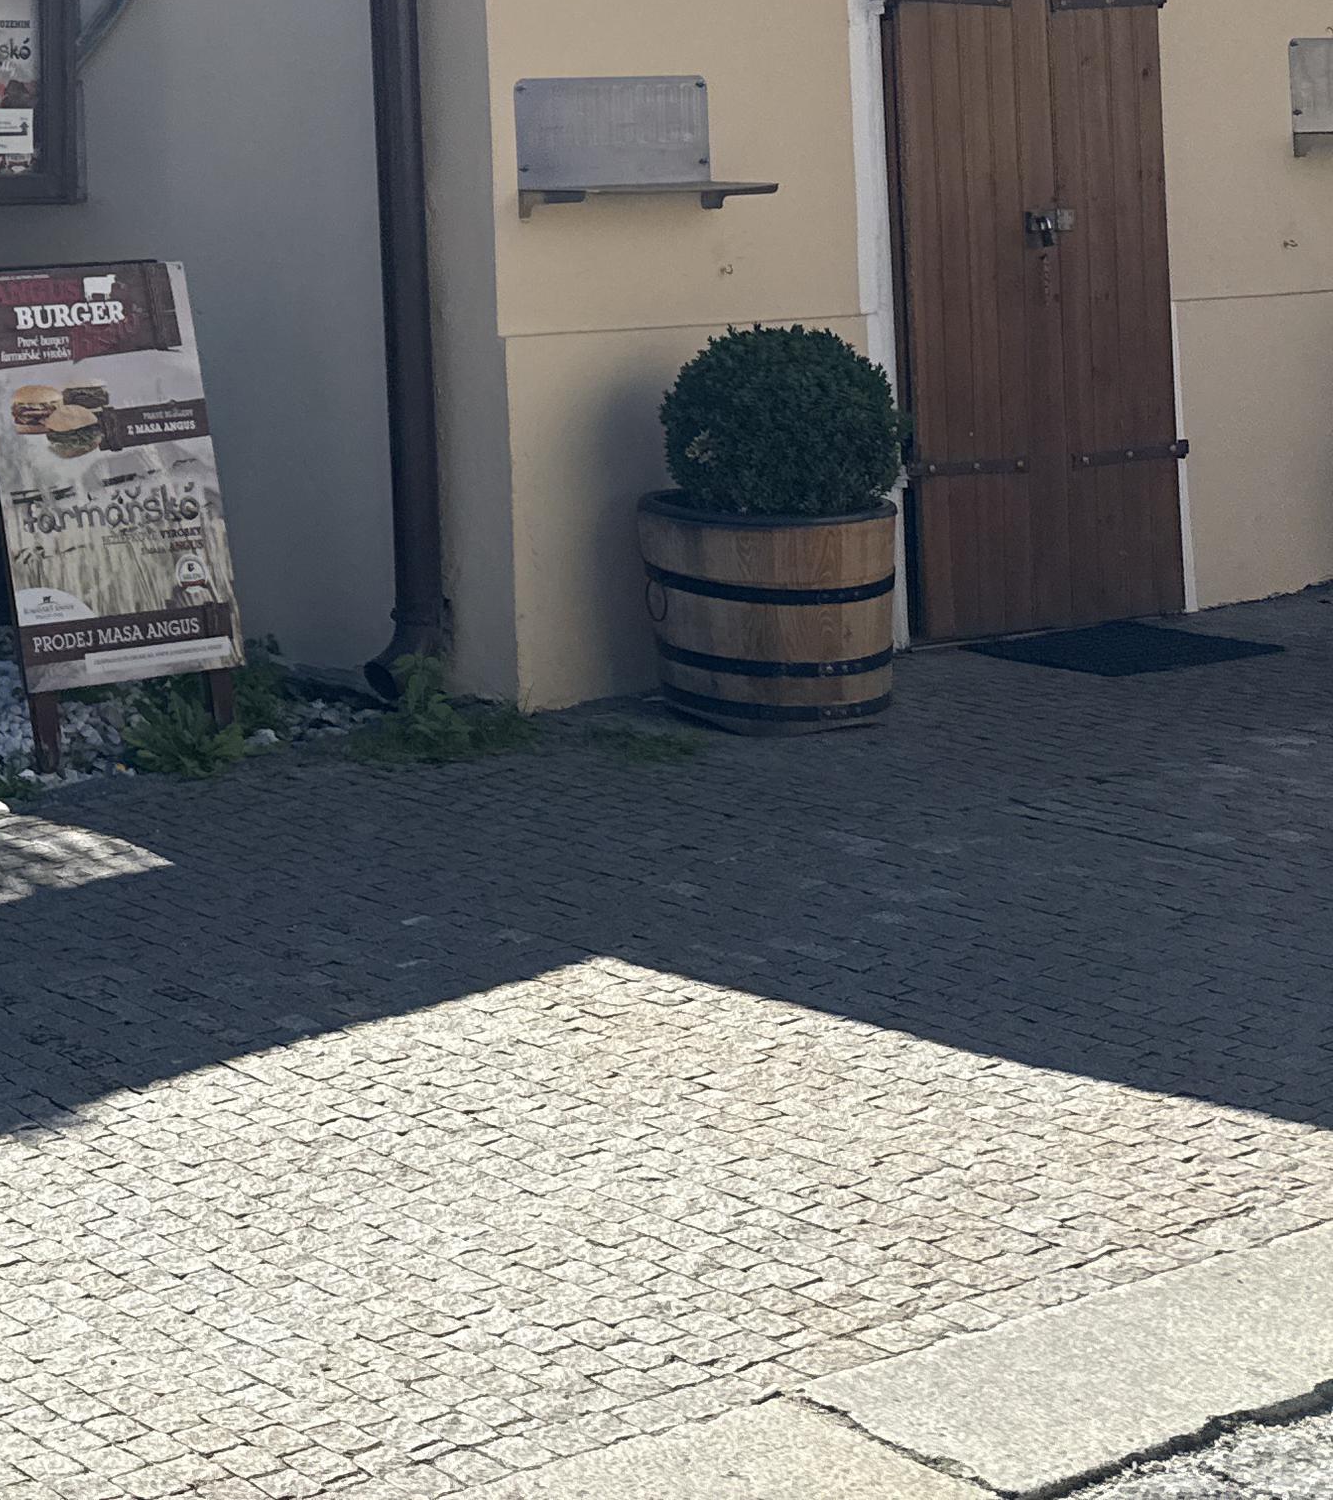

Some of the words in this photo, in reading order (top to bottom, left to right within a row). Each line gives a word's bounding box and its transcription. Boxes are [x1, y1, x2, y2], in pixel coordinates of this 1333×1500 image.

[13, 300, 125, 330] BURGER
[135, 423, 162, 434] MASA
[163, 420, 196, 432] ANGUS
[33, 631, 93, 653] PRODEJ
[97, 625, 142, 645] MASA
[146, 617, 201, 639] ANGUS
